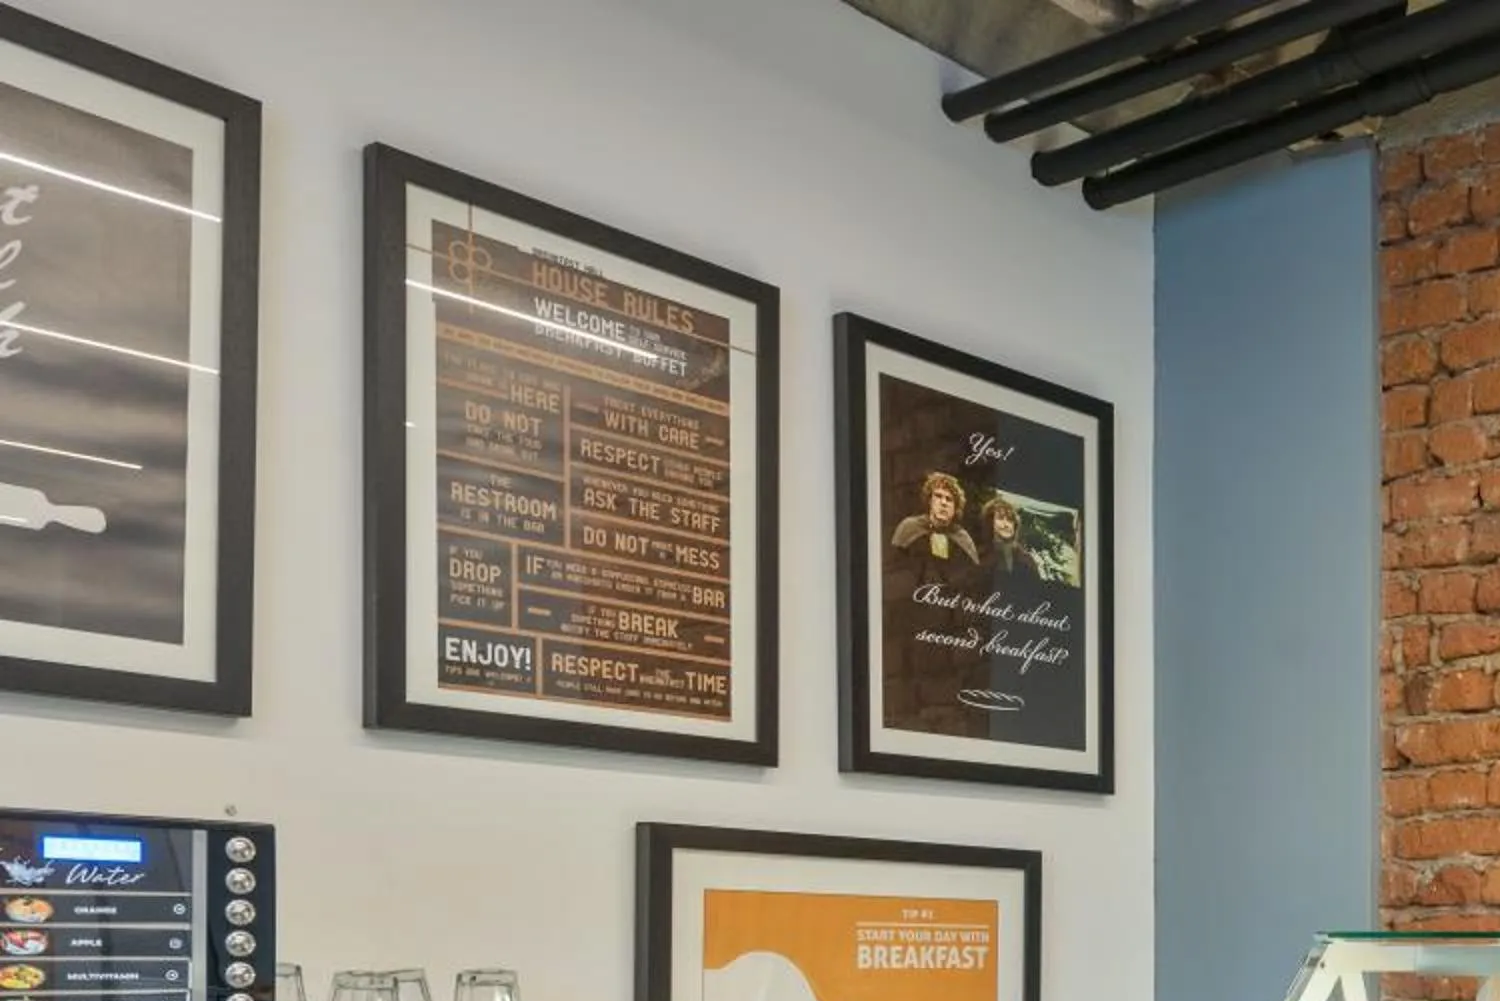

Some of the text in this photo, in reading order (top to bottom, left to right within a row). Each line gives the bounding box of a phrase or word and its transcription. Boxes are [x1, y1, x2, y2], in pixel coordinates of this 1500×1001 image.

[532, 260, 609, 306] HOUSE
[623, 291, 694, 334] RULES
[534, 296, 626, 342] WELCOME
[633, 350, 688, 377] BUFFET
[510, 382, 560, 415] HERE
[465, 400, 543, 437] DO NOT
[604, 409, 700, 450] WITH CARE
[641, 406, 700, 430] EVERYTHING
[580, 438, 661, 475] RESPECT
[965, 432, 1015, 466] Yes!
[490, 474, 512, 488] THE
[451, 481, 557, 521] RESTROOM
[583, 487, 721, 533] ASK THE STAFF
[583, 525, 607, 548] DO
[615, 532, 649, 556] NOT
[675, 544, 720, 570] MESS
[449, 557, 502, 584] DROP
[526, 555, 545, 576] IF
[691, 585, 726, 609] BAR
[913, 583, 1071, 633] But what about
[618, 610, 680, 639] BREAK
[445, 637, 532, 672] ENJOY!
[915, 628, 1070, 675] second breakfast?
[551, 652, 639, 684] RESPECT
[684, 671, 727, 696] TIME
[65, 863, 145, 885] Water
[74, 906, 118, 915] ORANGE
[902, 909, 919, 920] TIP
[70, 938, 103, 947] APPLE
[857, 928, 990, 945] START YOUR DAY WITH
[857, 944, 989, 970] BREAKFAST
